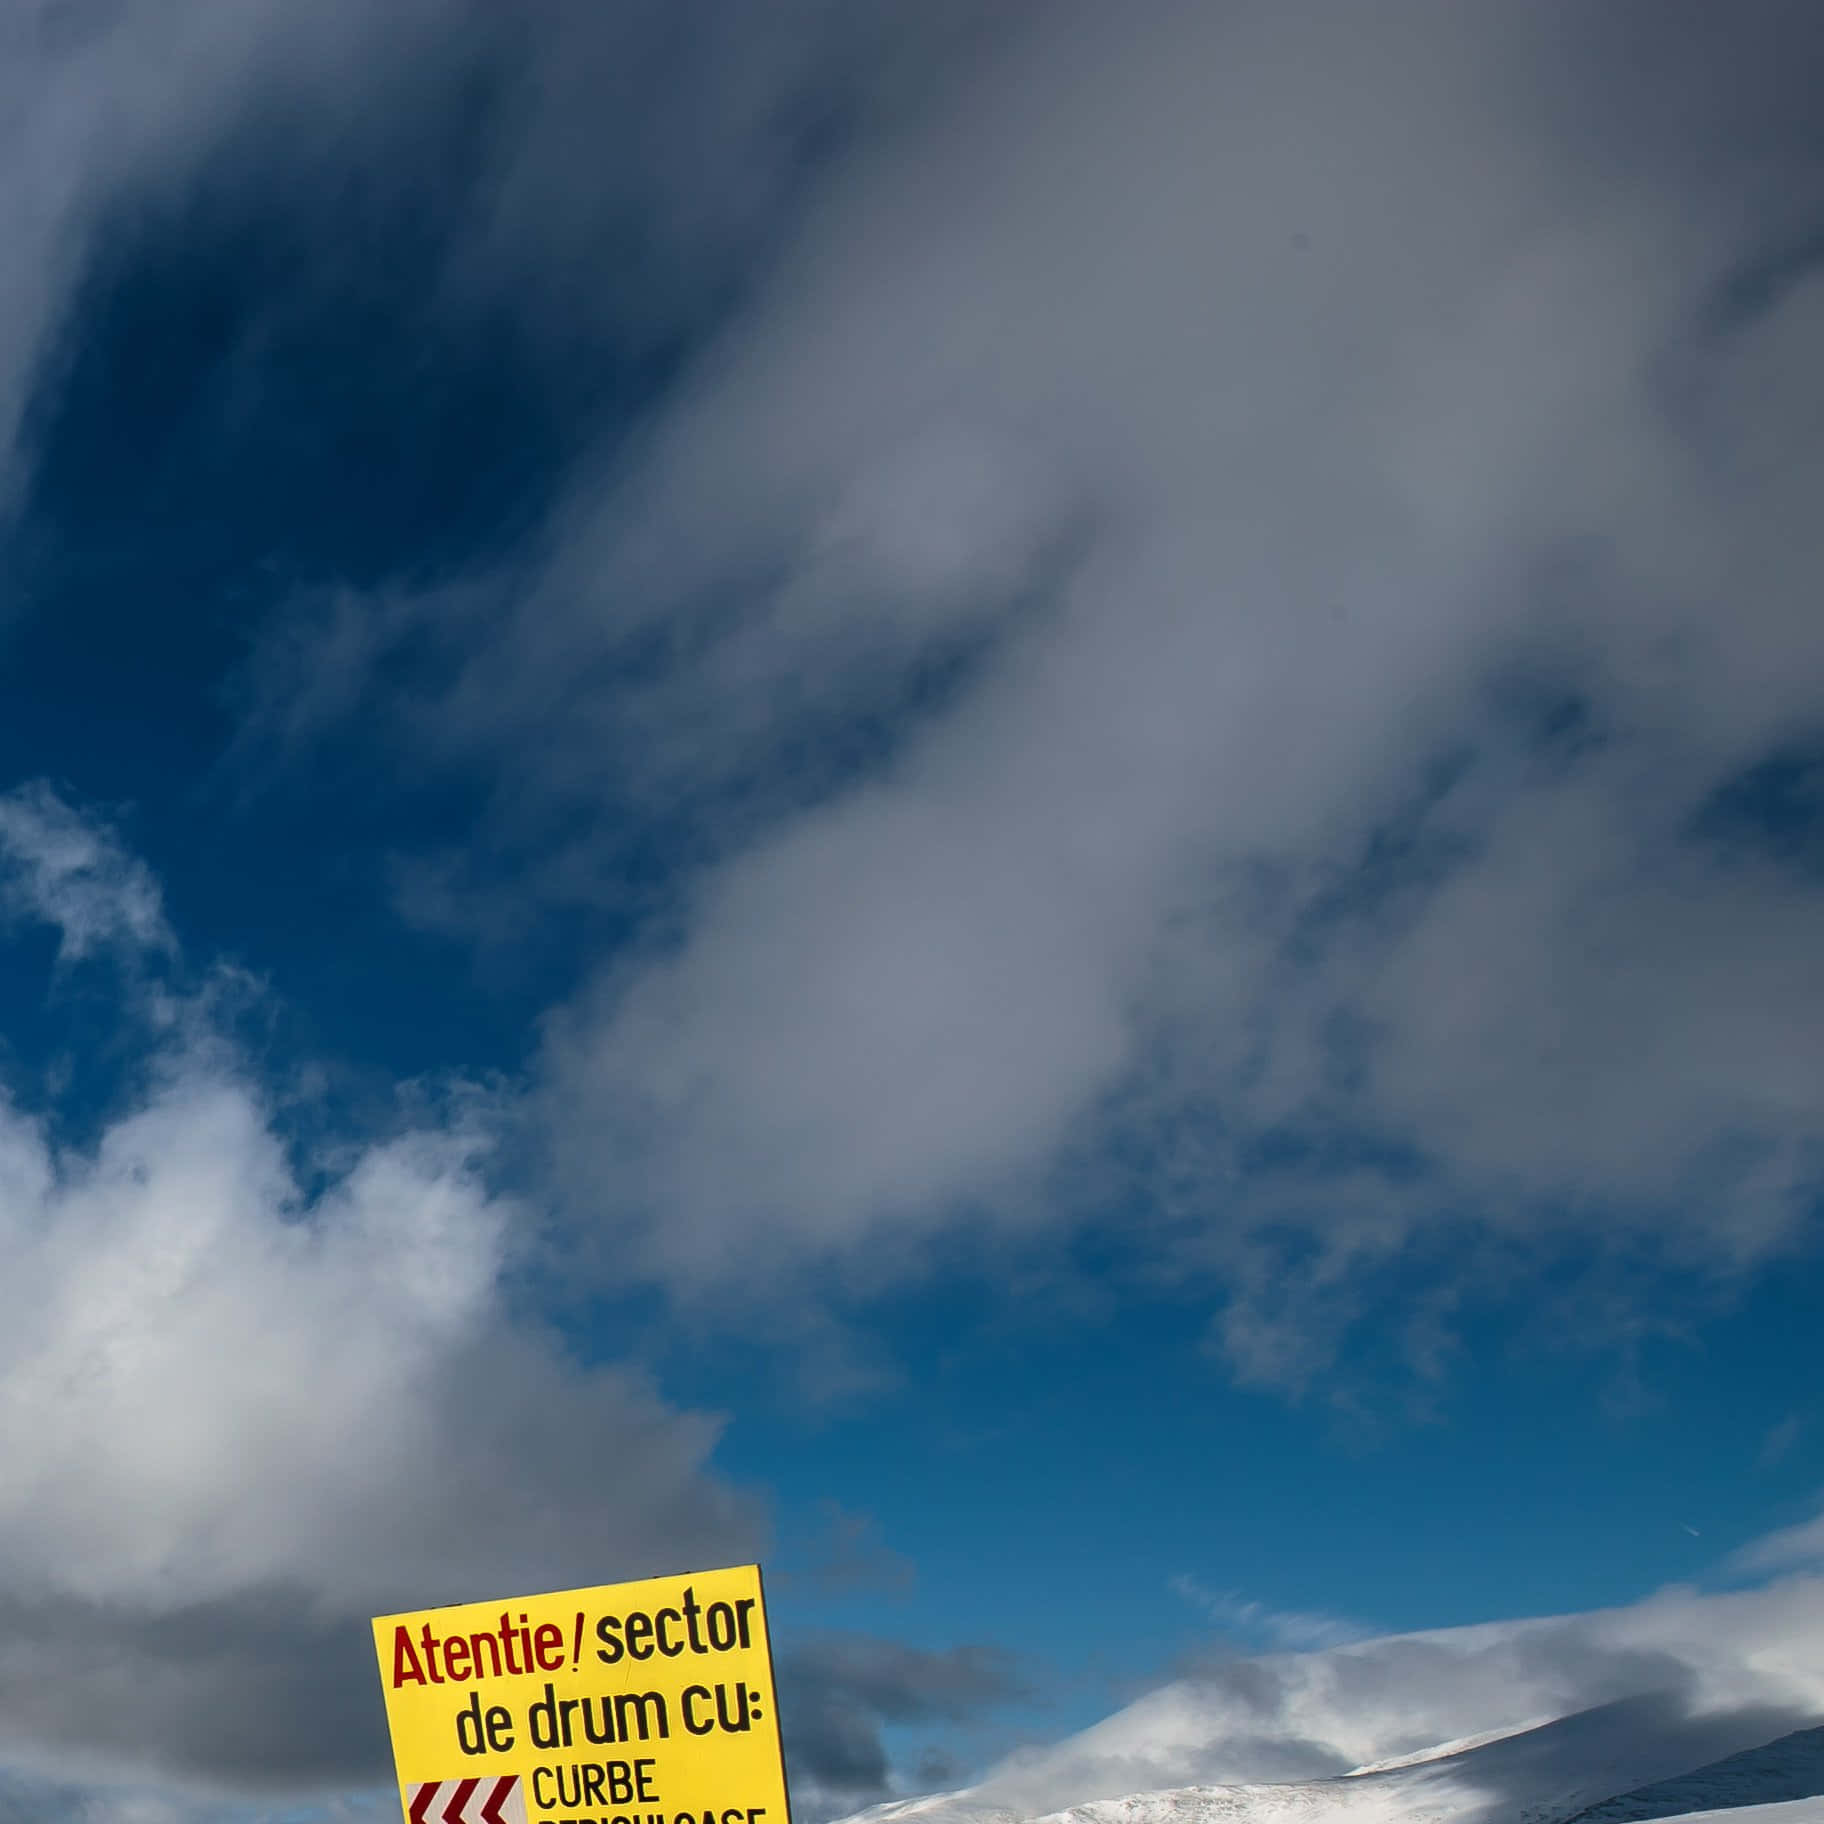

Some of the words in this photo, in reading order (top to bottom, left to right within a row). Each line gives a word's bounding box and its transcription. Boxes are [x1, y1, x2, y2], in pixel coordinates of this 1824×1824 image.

[595, 1586, 755, 1665] sector
[456, 1691, 515, 1756] de
[528, 1683, 669, 1749] drum
[681, 1682, 763, 1735] cu:
[532, 1758, 660, 1810] CURBE
